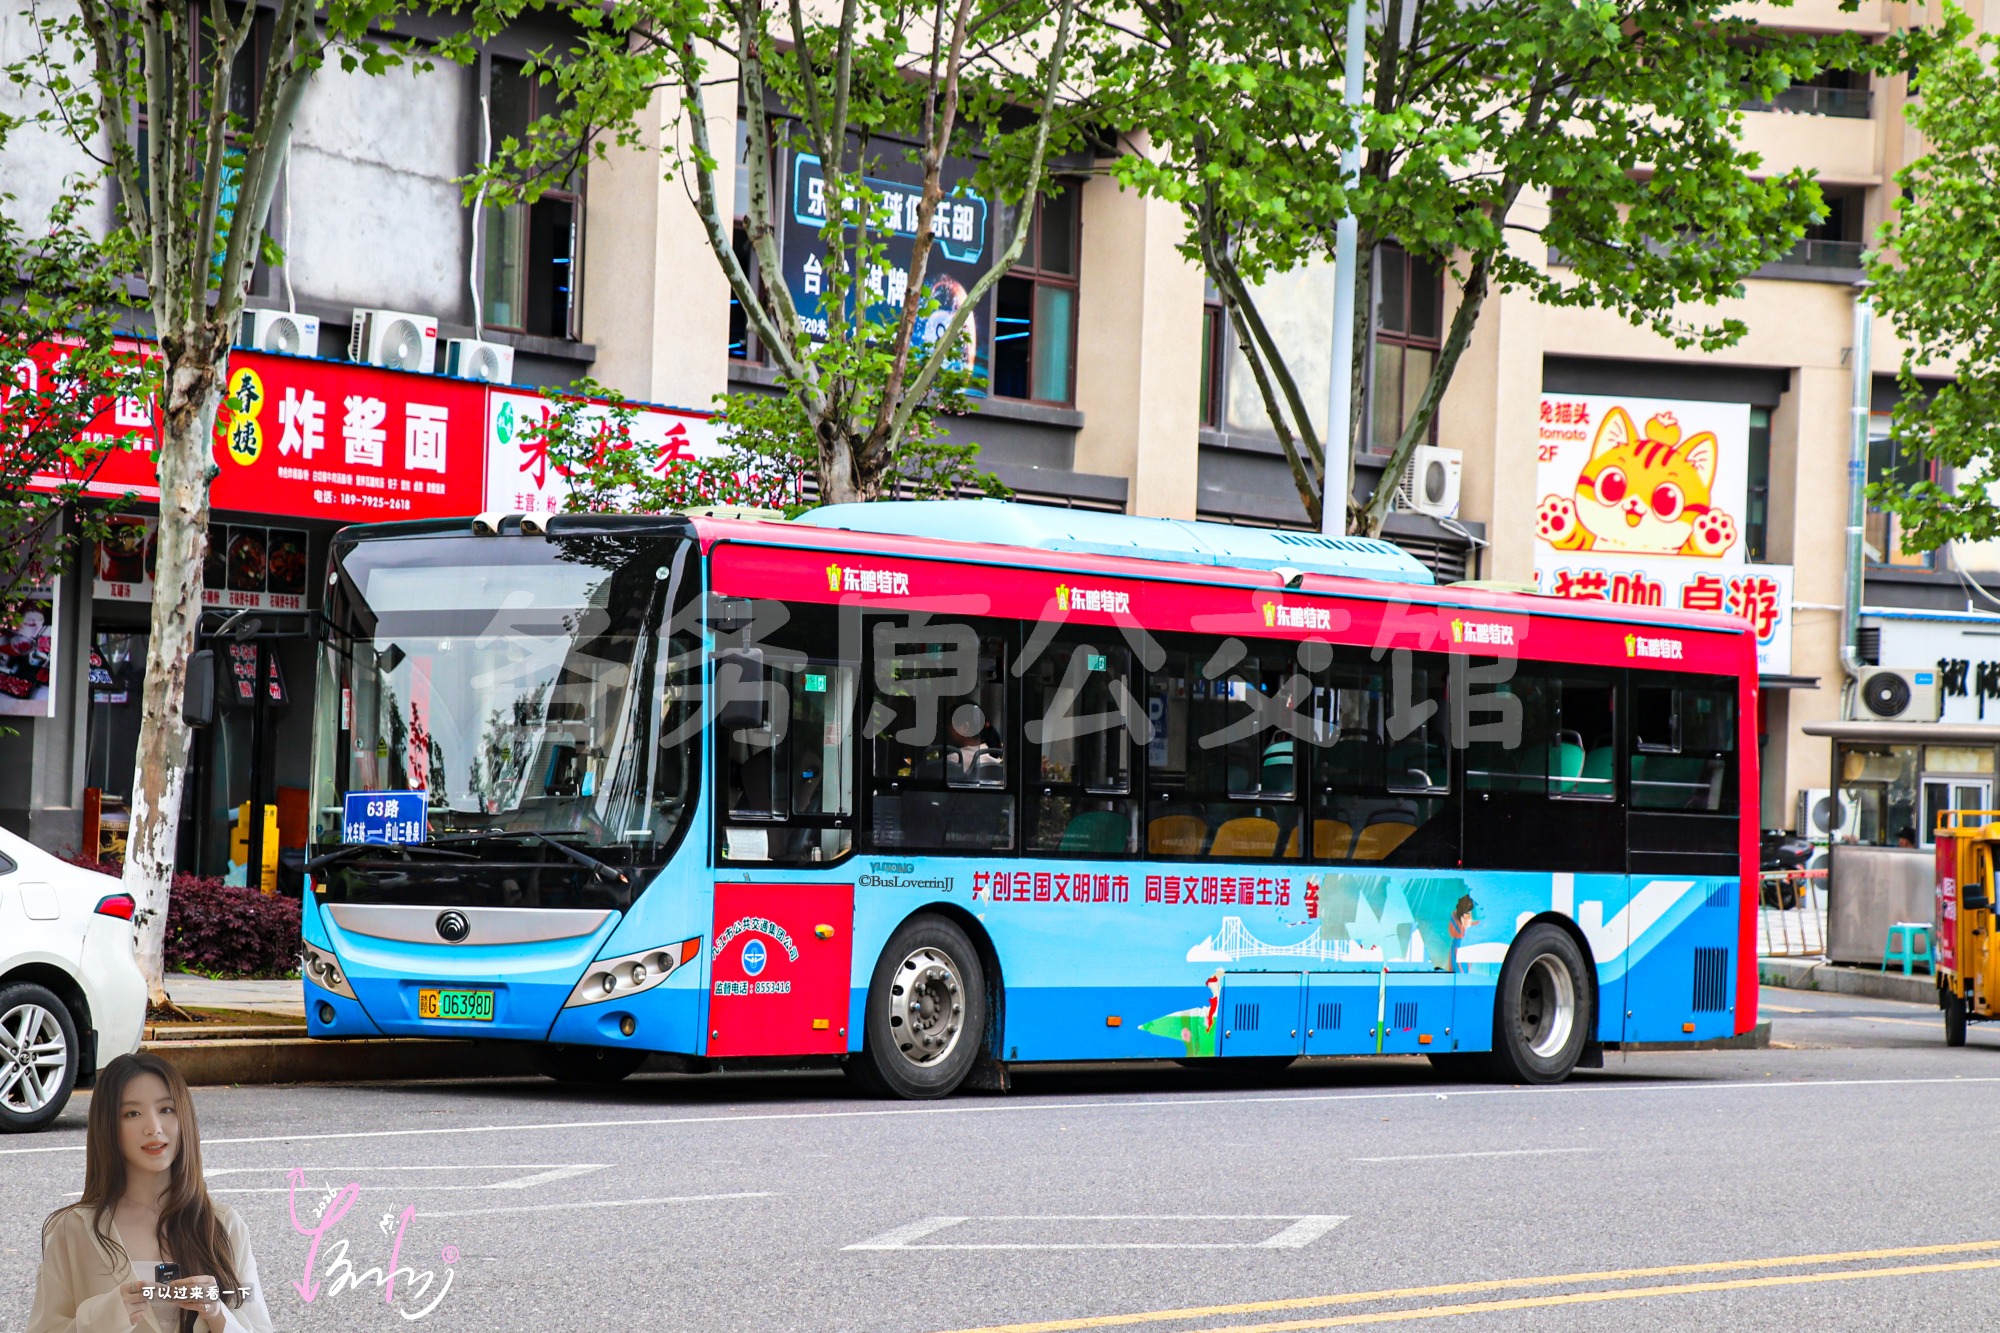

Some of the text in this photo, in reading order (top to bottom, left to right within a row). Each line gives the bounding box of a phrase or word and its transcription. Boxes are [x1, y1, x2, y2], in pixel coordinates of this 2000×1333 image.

[808, 177, 974, 242] 乐球俱乐部
[803, 253, 908, 307] 台棋牌
[278, 387, 449, 474] 炸酱面
[1539, 445, 1558, 462] 2F
[843, 567, 910, 596] 东鹏特饮
[1070, 586, 1130, 614] 东鹏特饮
[1683, 576, 1779, 638] 桌游
[1276, 604, 1332, 630] 东鹏特饮
[1463, 620, 1515, 646] 东鹏特饮
[1636, 636, 1684, 660] 东鹏特饮
[366, 799, 400, 819] 63路
[869, 862, 915, 874] YUTONG
[972, 871, 1130, 903] 共创全国文明城市
[1145, 875, 1291, 906] 同享文明幸福生活
